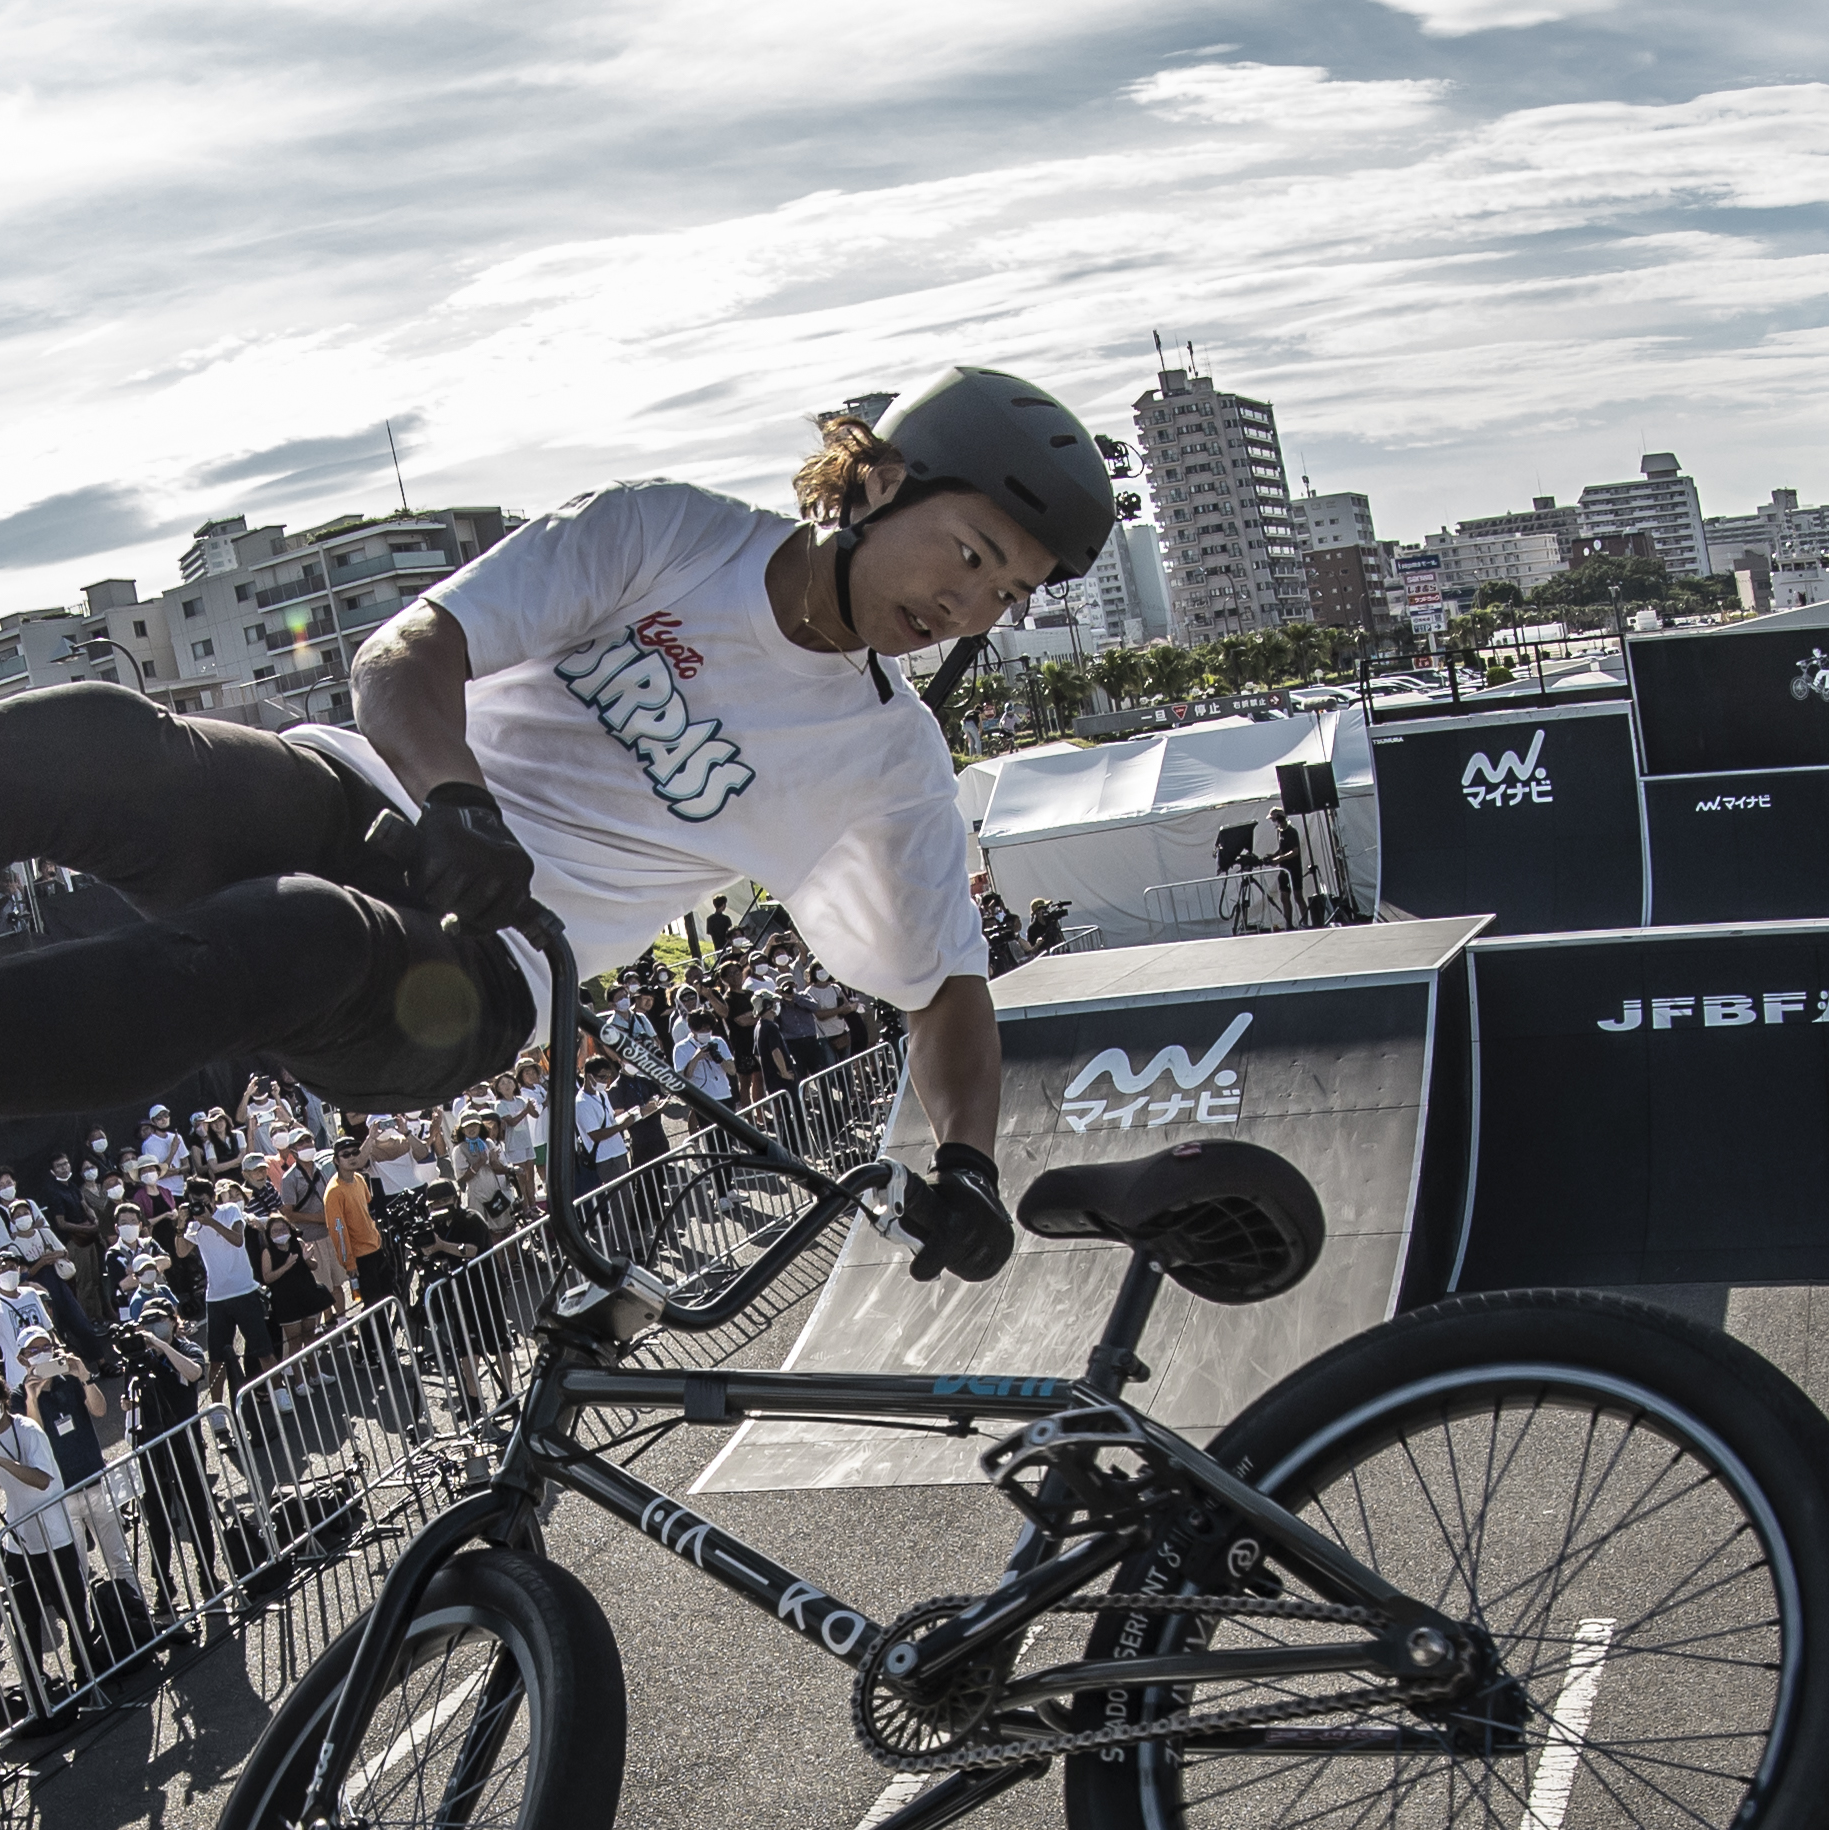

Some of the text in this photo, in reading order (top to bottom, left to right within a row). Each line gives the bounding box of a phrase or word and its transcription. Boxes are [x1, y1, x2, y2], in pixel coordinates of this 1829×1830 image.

[636, 611, 704, 679] Kyoto
[1194, 702, 1221, 716] 停止
[1463, 780, 1553, 809] マイナビ
[1725, 794, 1771, 810] マイナビ
[1596, 990, 1810, 1032] JFBF
[623, 1040, 686, 1092] Shadow
[1062, 1088, 1240, 1134] マイナビ
